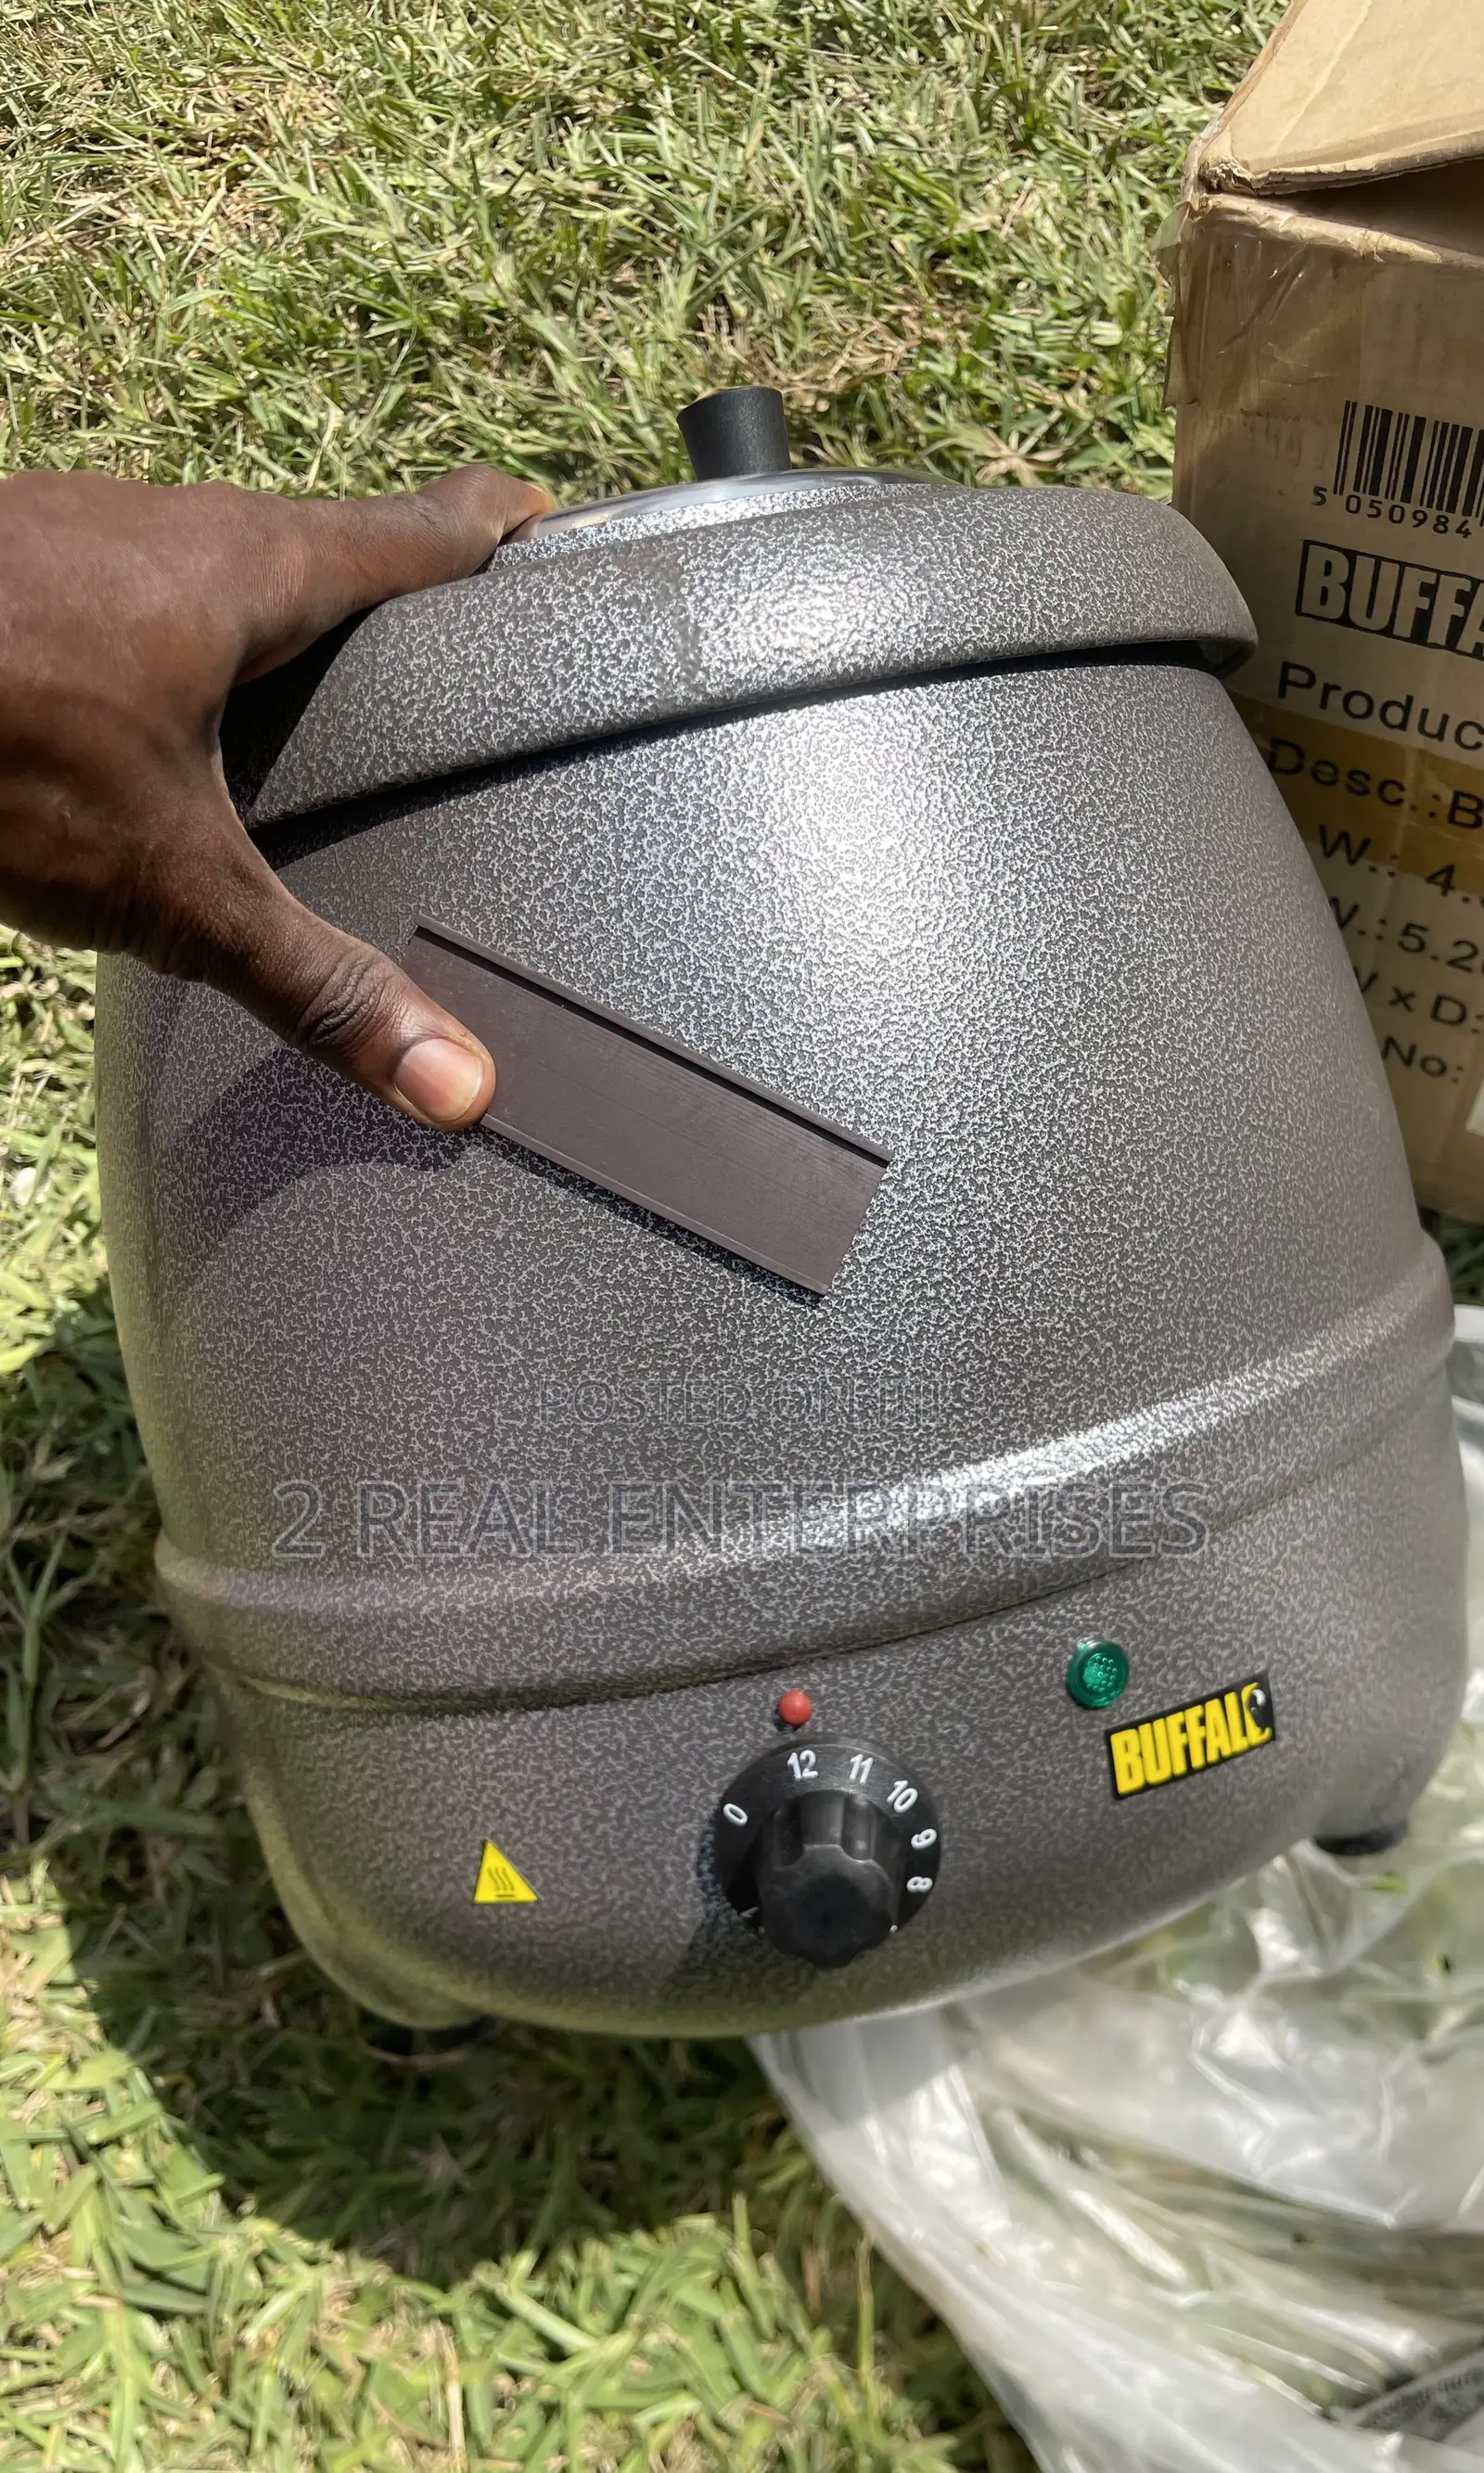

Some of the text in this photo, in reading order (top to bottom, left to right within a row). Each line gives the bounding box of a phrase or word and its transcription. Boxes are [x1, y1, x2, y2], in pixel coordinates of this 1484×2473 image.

[1311, 485, 1473, 539] 5 050984
[1277, 660, 1484, 751] Produc
[1424, 864, 1484, 908] 4.
[1381, 1035, 1465, 1084] No:
[787, 1749, 819, 1781] 12
[849, 1753, 874, 1785] 11
[886, 1780, 919, 1813] 10
[723, 1802, 748, 1826] 0
[911, 1828, 938, 1850] 9
[905, 1876, 933, 1893] 8
